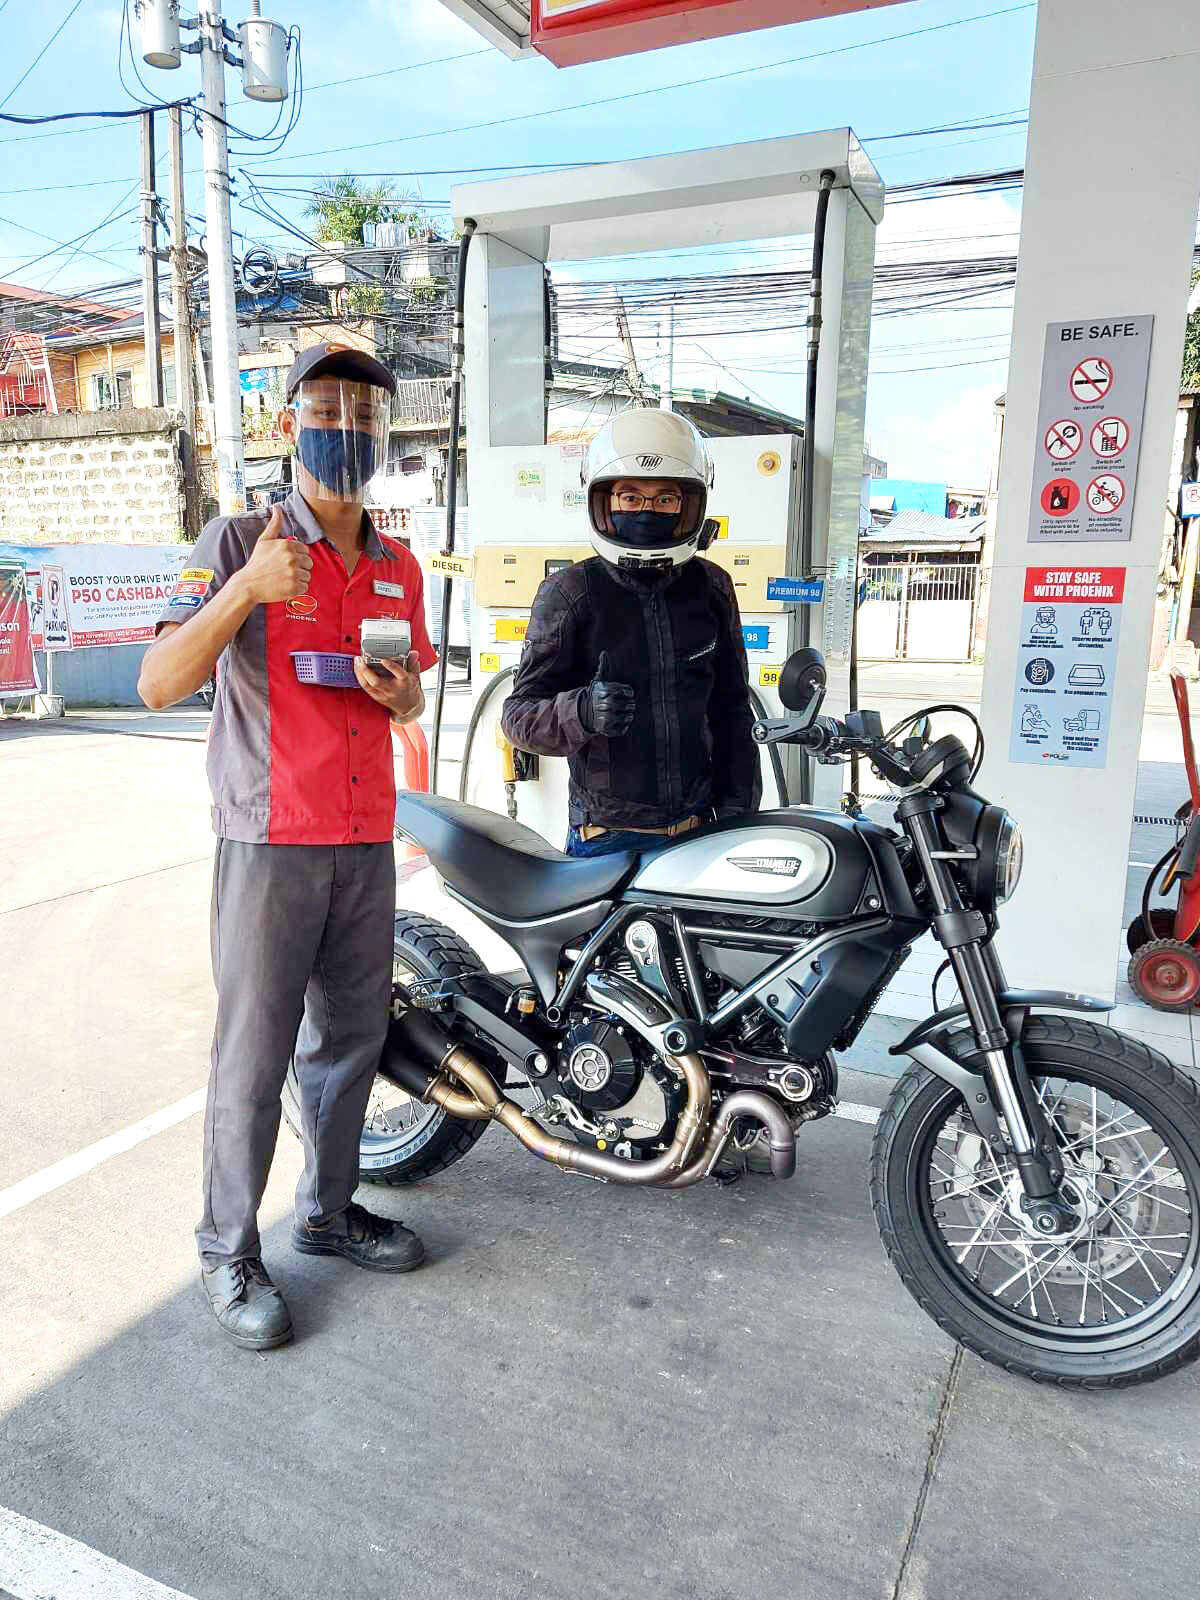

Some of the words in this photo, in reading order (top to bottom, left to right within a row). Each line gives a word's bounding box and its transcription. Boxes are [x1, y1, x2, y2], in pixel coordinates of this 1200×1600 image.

[1061, 327, 1084, 341] BE
[1089, 323, 1139, 339] SAFE.
[432, 560, 464, 573] DIESEL
[70, 576, 104, 586] BOOST
[105, 575, 132, 585] YOUR
[134, 574, 161, 584] DRIVE
[163, 573, 180, 582] WIT
[1046, 572, 1073, 584] STAY
[1074, 572, 1102, 584] SAFE
[72, 588, 102, 604] P50
[769, 587, 809, 597] PREMIUM
[1033, 585, 1064, 597] WITH
[1065, 585, 1114, 598] PHOENIX
[0, 622, 20, 632] son
[45, 621, 67, 632] PARKING
[746, 632, 758, 642] 98
[763, 673, 777, 682] 98
